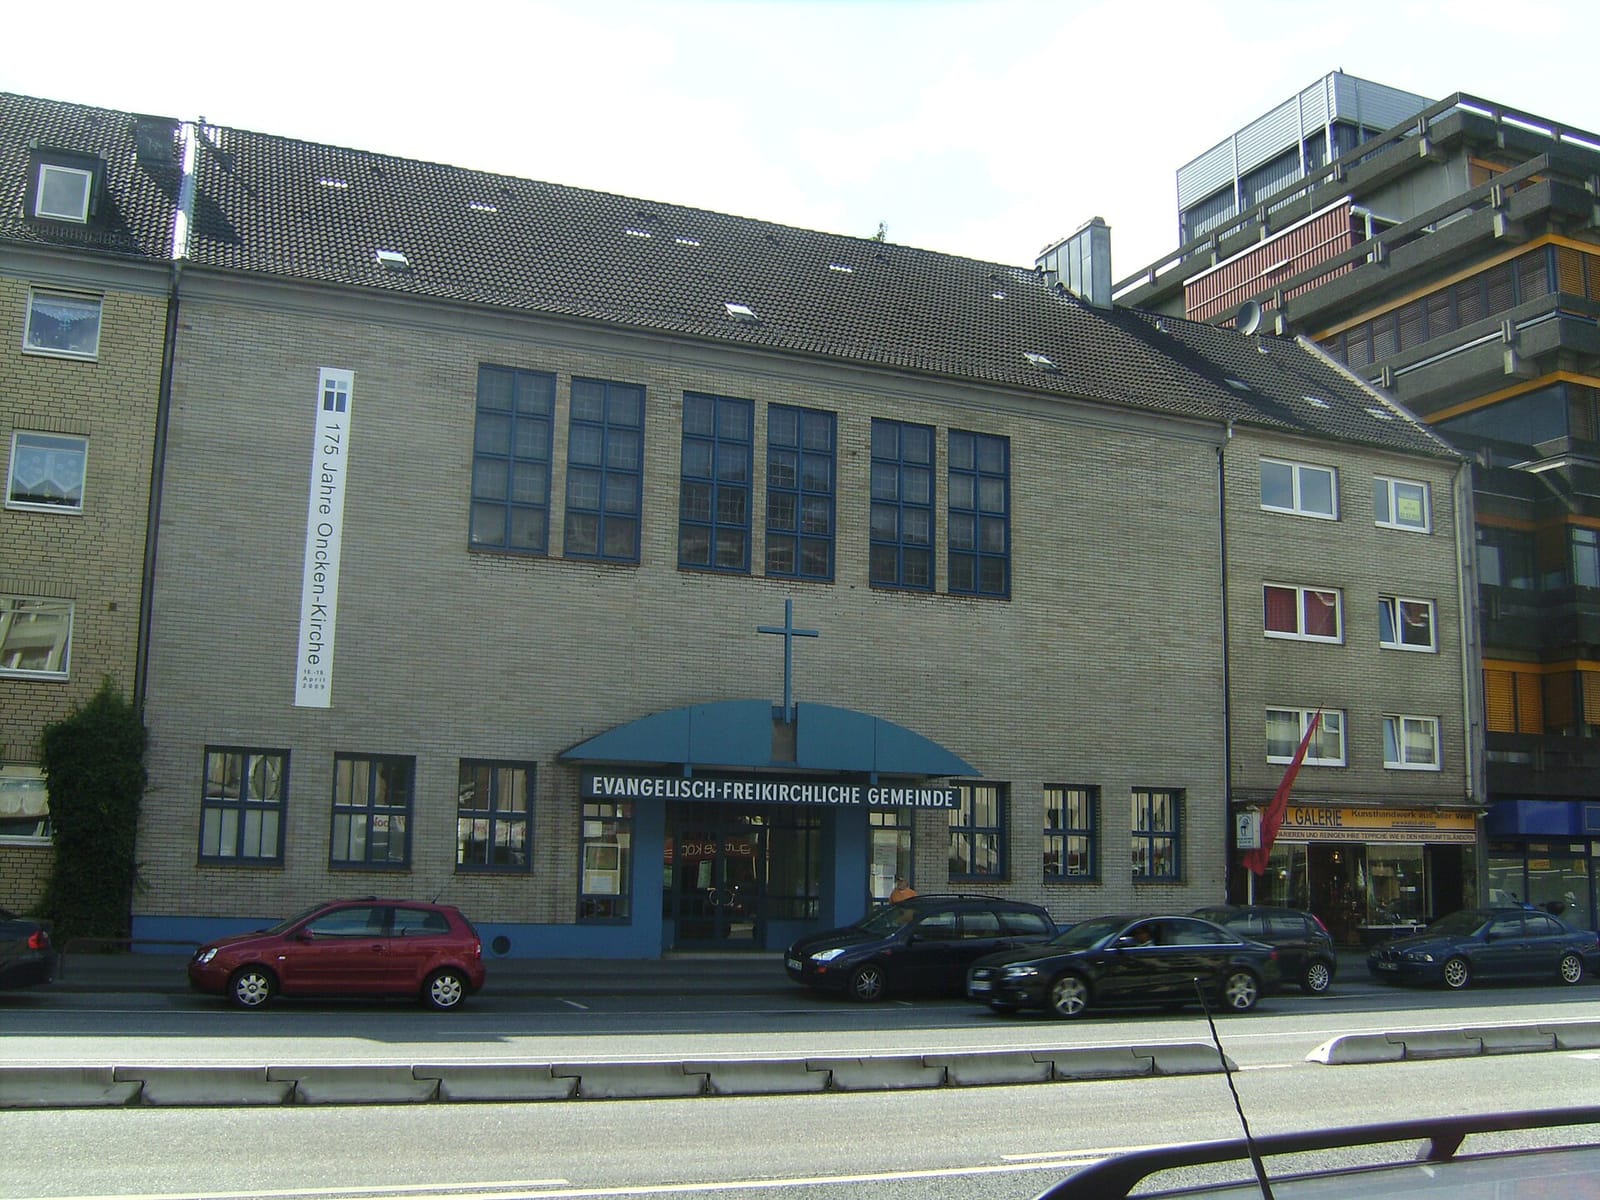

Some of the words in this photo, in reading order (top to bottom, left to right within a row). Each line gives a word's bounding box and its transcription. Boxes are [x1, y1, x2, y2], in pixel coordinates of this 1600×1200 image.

[323, 423, 341, 455] 175
[318, 462, 338, 515] Jahre
[307, 523, 334, 665] Oncken-Kirche
[592, 776, 861, 804] EVANGELISCH-FREIKIRCHLICHE
[867, 787, 954, 807] GEMEINDE
[1295, 806, 1342, 827] GALERIE
